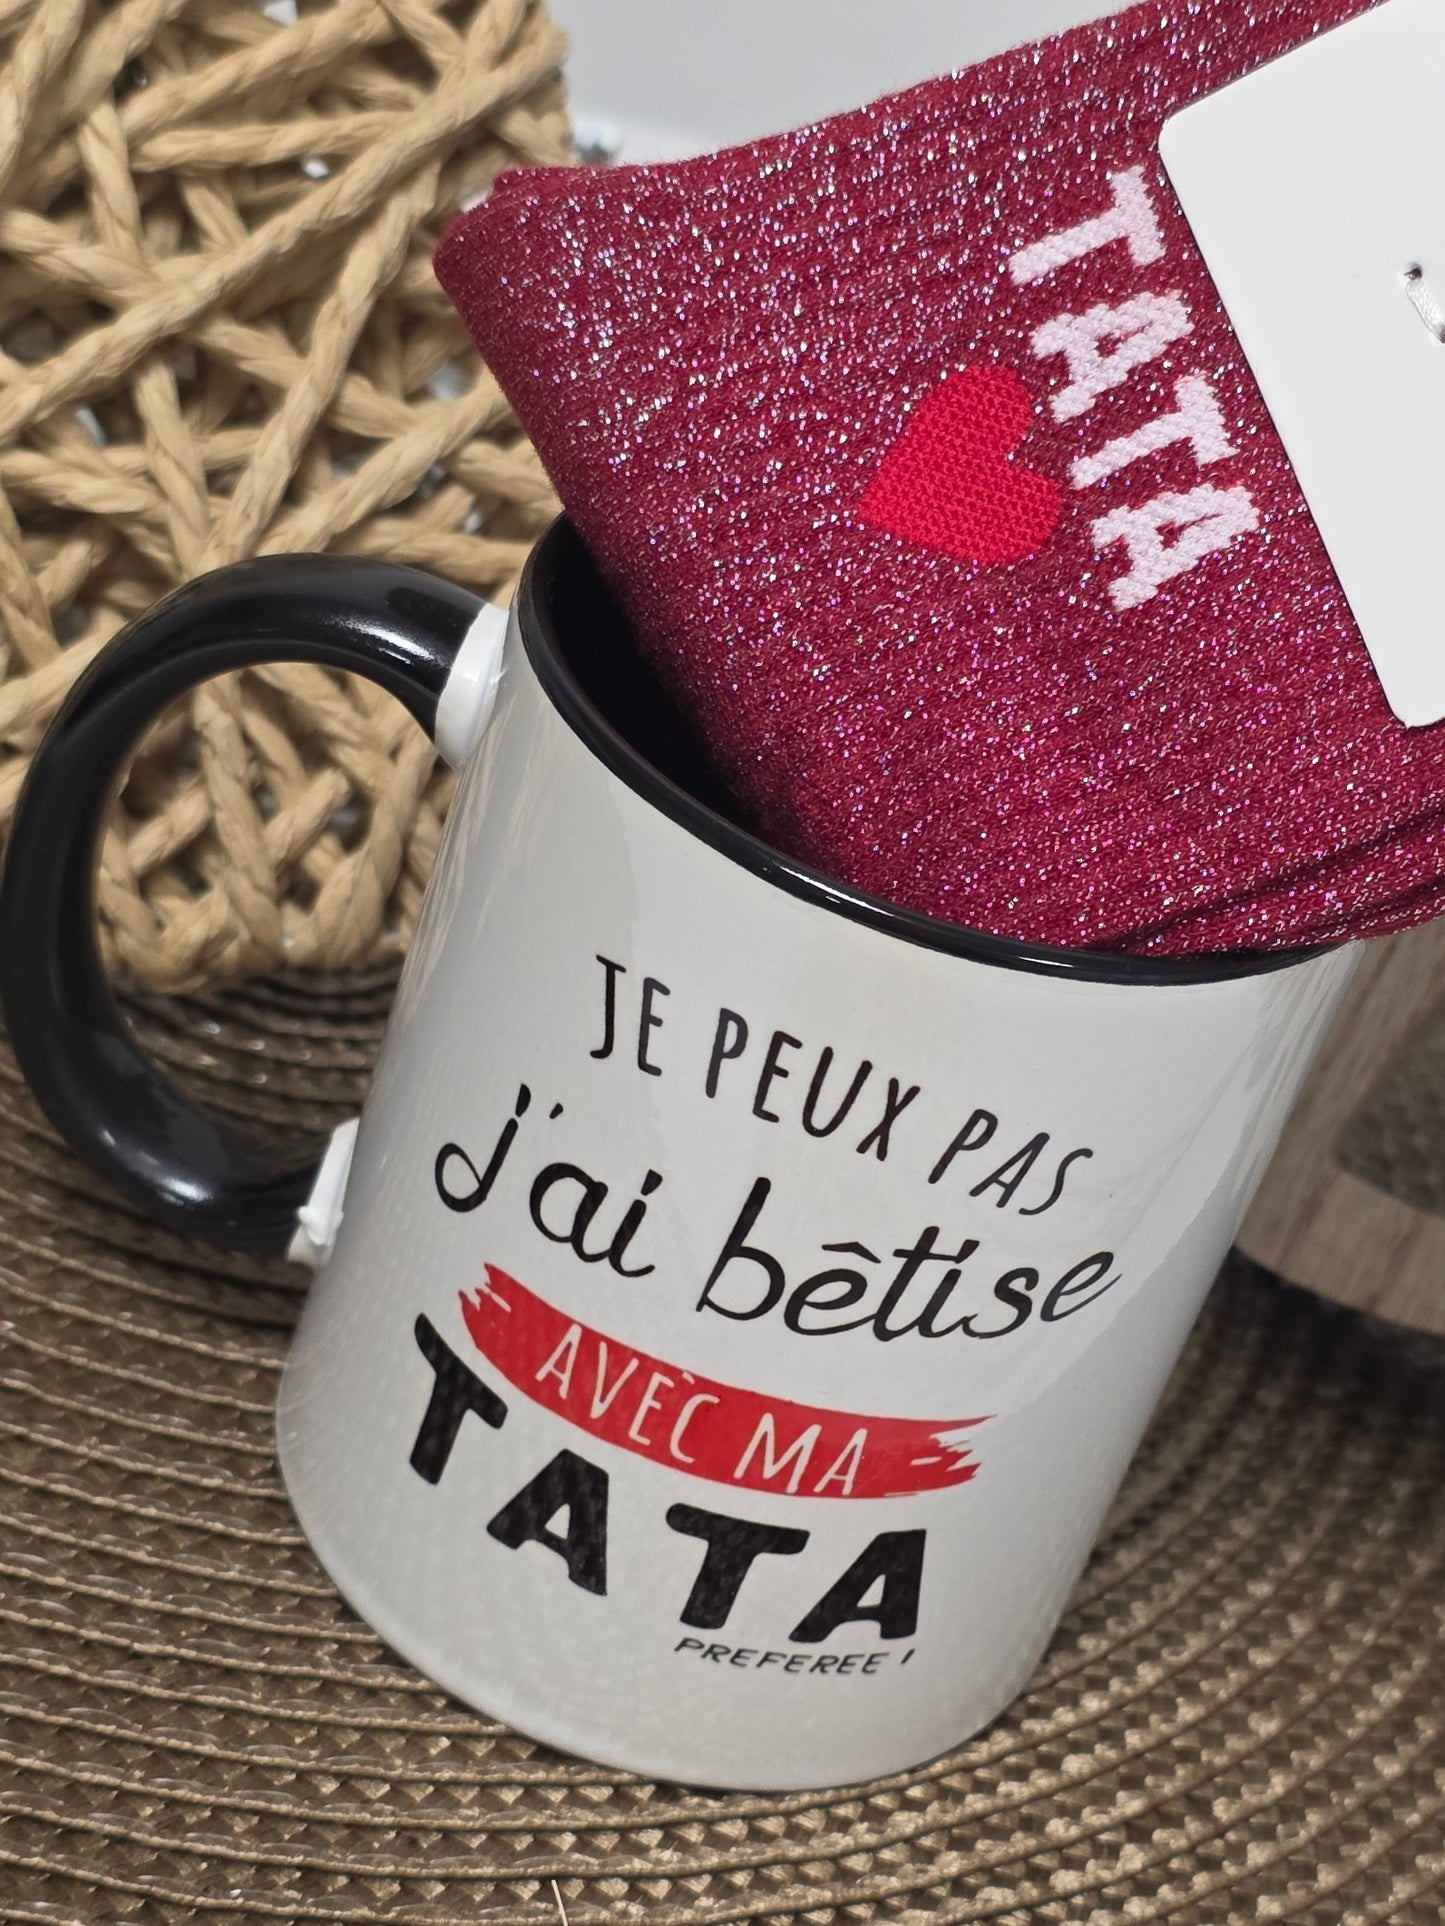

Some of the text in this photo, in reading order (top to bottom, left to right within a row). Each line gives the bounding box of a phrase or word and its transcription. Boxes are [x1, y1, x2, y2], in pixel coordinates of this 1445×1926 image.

[1008, 165, 1261, 611] TATA
[435, 1083, 1121, 1342] j'ai bêtise
[590, 954, 1093, 1216] JE PEUX PAS
[409, 1311, 927, 1643] TATA
[733, 1413, 869, 1496] MA
[673, 1636, 891, 1676] PREFEREE
